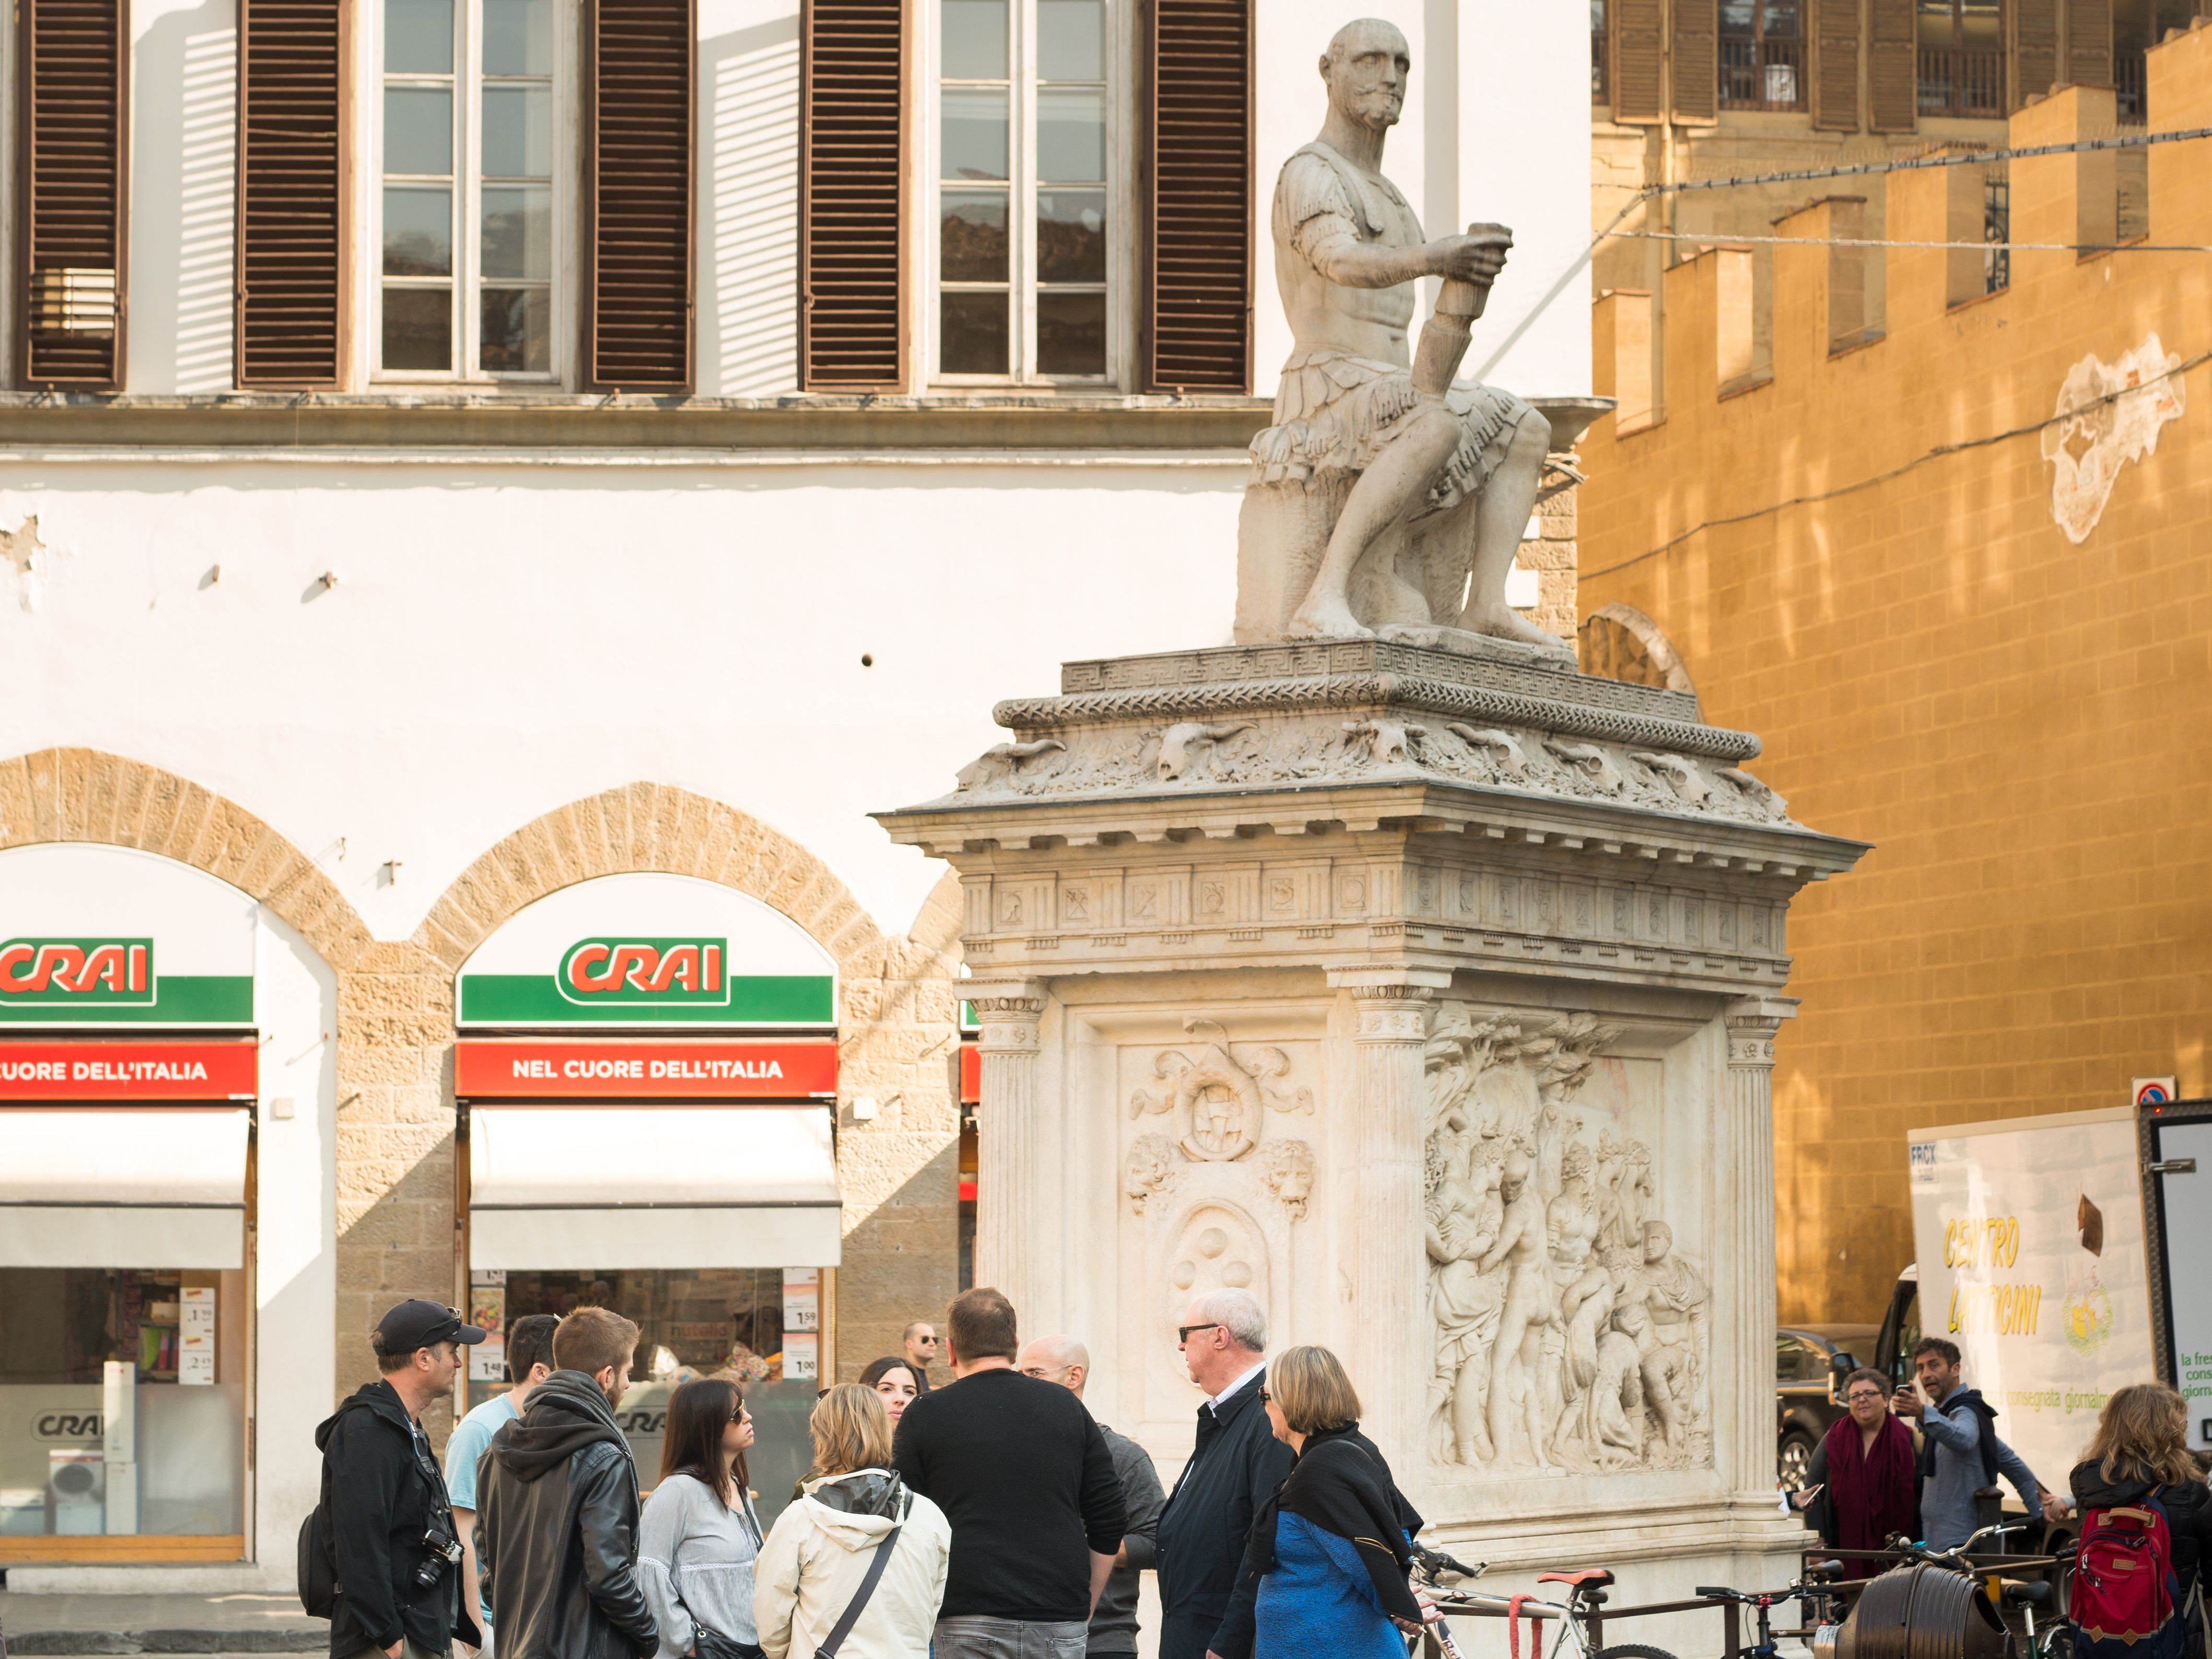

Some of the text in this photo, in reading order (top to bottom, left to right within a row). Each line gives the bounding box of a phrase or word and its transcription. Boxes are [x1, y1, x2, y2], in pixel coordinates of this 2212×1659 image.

[0, 943, 146, 993] CRAI
[567, 943, 720, 992] CRAI
[0, 1062, 208, 1080] UORE DELL'ITALIA
[513, 1061, 783, 1078] NEL CUORE DELL'ITALIA
[1944, 1216, 2019, 1268] CENTRO
[1948, 1284, 2041, 1335] LATTICINI
[2181, 1353, 2191, 1367] la
[2007, 1387, 2060, 1412] consegnata
[2182, 1383, 2212, 1400] giorn
